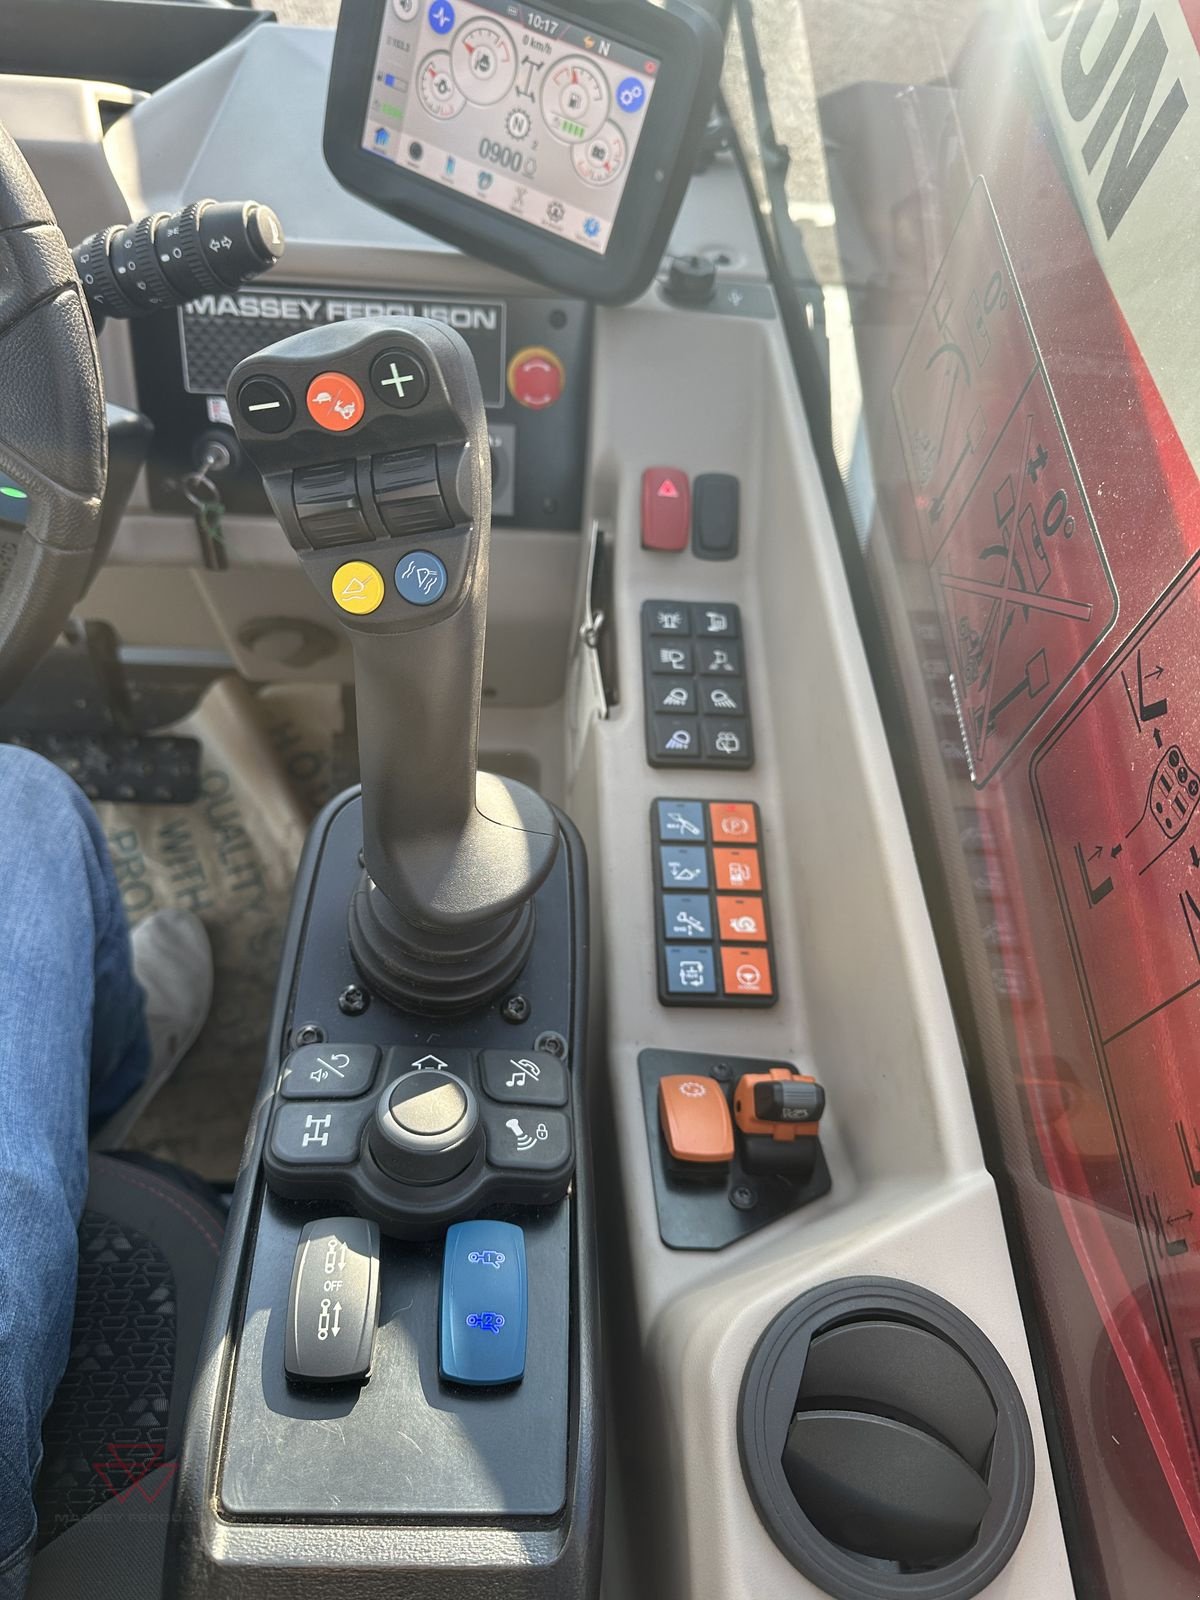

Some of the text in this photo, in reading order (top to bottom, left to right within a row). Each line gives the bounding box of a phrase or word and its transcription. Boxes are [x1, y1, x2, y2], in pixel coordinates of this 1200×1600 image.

[527, 13, 559, 34] 10:17
[522, 34, 553, 55] 0 km/h
[598, 40, 611, 57] N
[512, 116, 524, 133] N
[1038, 0, 1189, 241] ON
[479, 138, 523, 173] 0900
[184, 294, 321, 321] MASSEY
[323, 1280, 343, 1291] OFF
